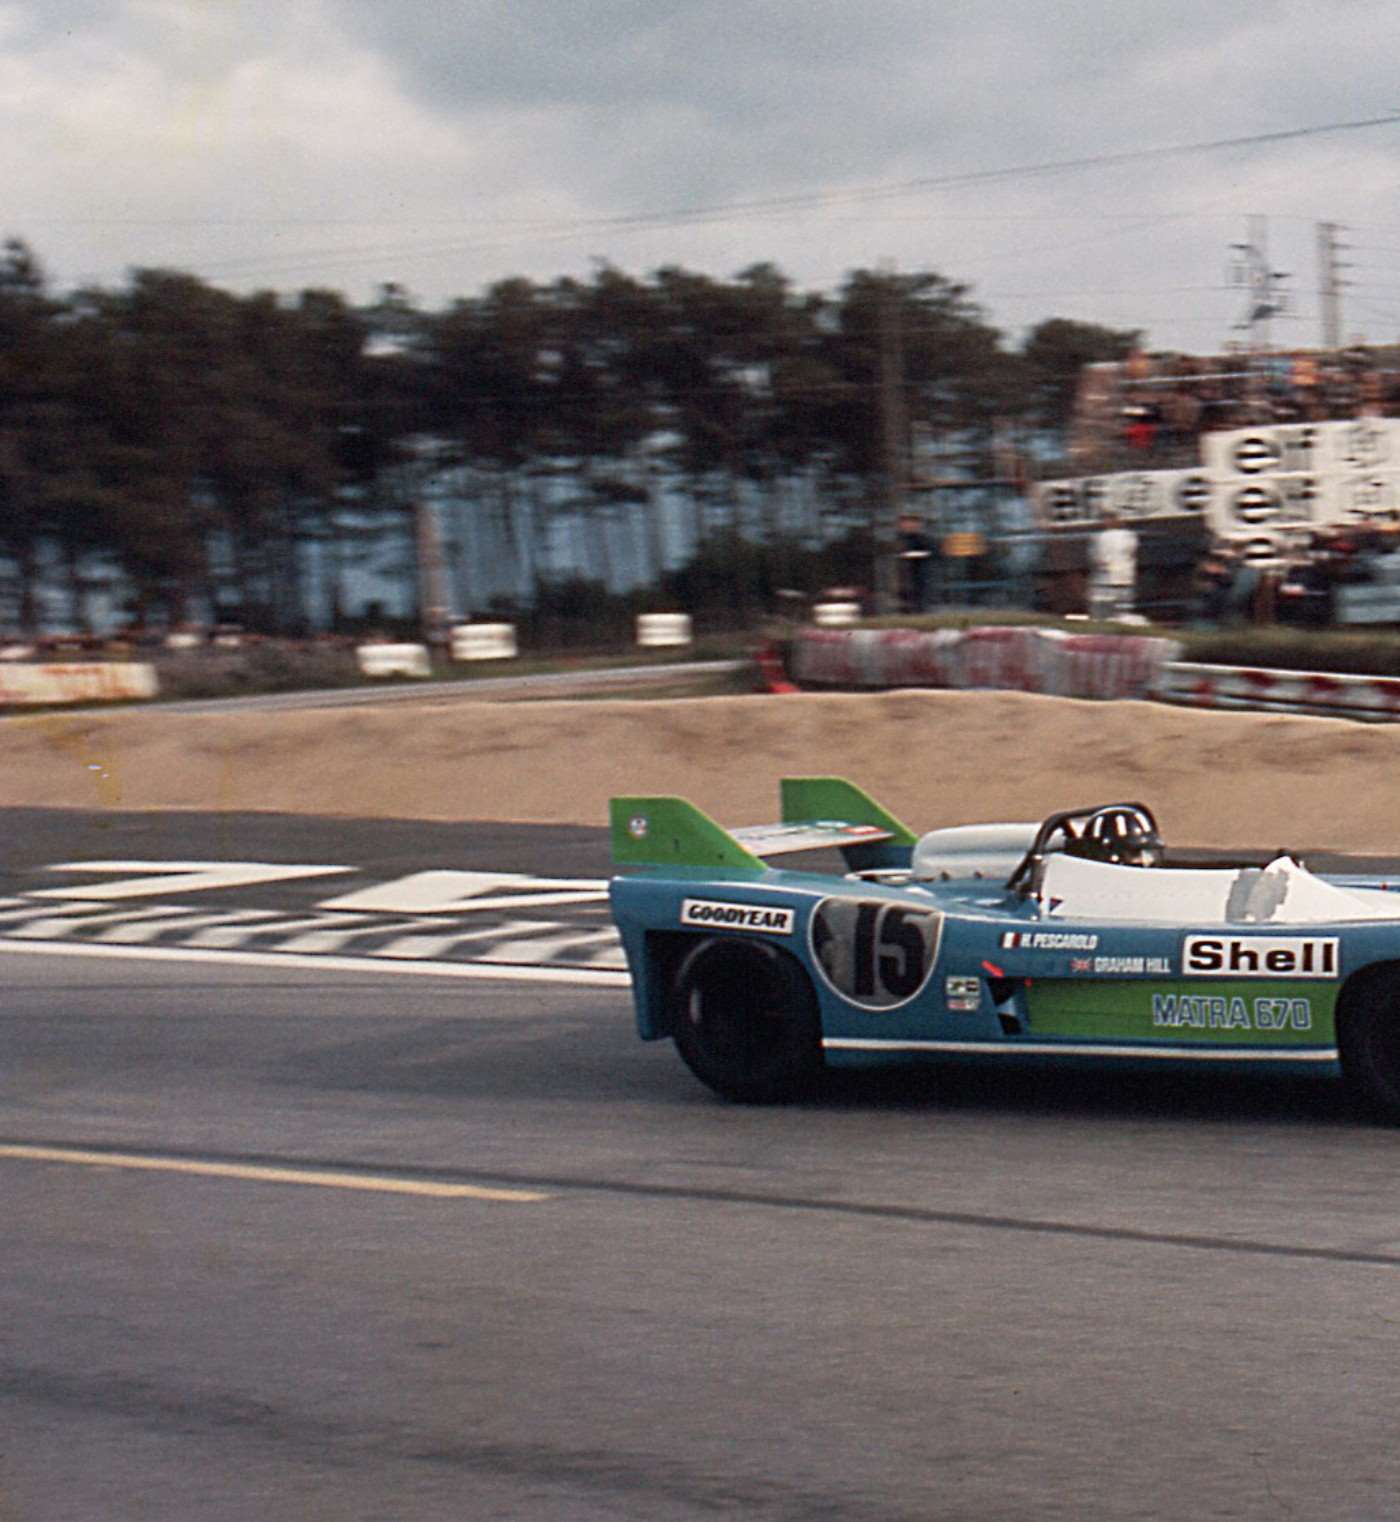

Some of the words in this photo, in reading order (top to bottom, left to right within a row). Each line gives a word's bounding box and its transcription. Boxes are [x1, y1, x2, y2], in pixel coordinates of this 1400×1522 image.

[687, 903, 788, 927] GOODYEAR
[855, 901, 926, 995] 15
[1035, 933, 1098, 950] PESCAROLO
[1094, 957, 1143, 973] GRAHAM
[1146, 958, 1171, 973] HILL
[1189, 940, 1334, 973] Shell
[1152, 993, 1252, 1029] MATRA
[1254, 998, 1312, 1030] 670
